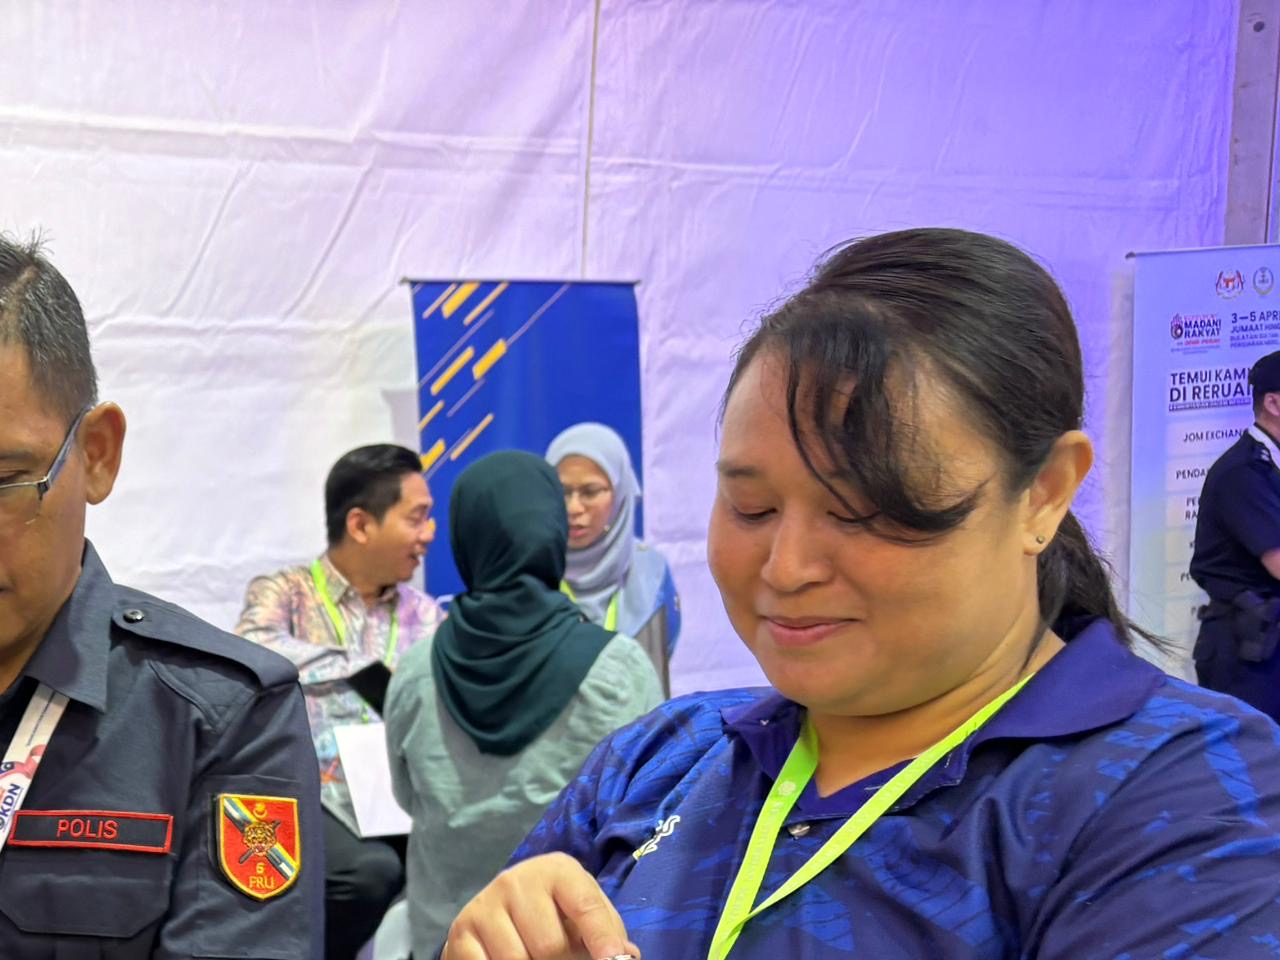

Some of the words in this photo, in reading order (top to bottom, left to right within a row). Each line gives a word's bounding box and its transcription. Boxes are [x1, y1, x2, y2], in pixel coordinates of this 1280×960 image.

[1184, 319, 1221, 329] MADANI
[1184, 328, 1221, 338] RAKYAT
[1171, 370, 1211, 385] TEMUI
[1170, 386, 1187, 402] DI
[1183, 431, 1204, 442] JOM
[1205, 428, 1244, 440] EXCHAN
[56, 818, 119, 840] POLIS
[248, 875, 275, 889] FRU
